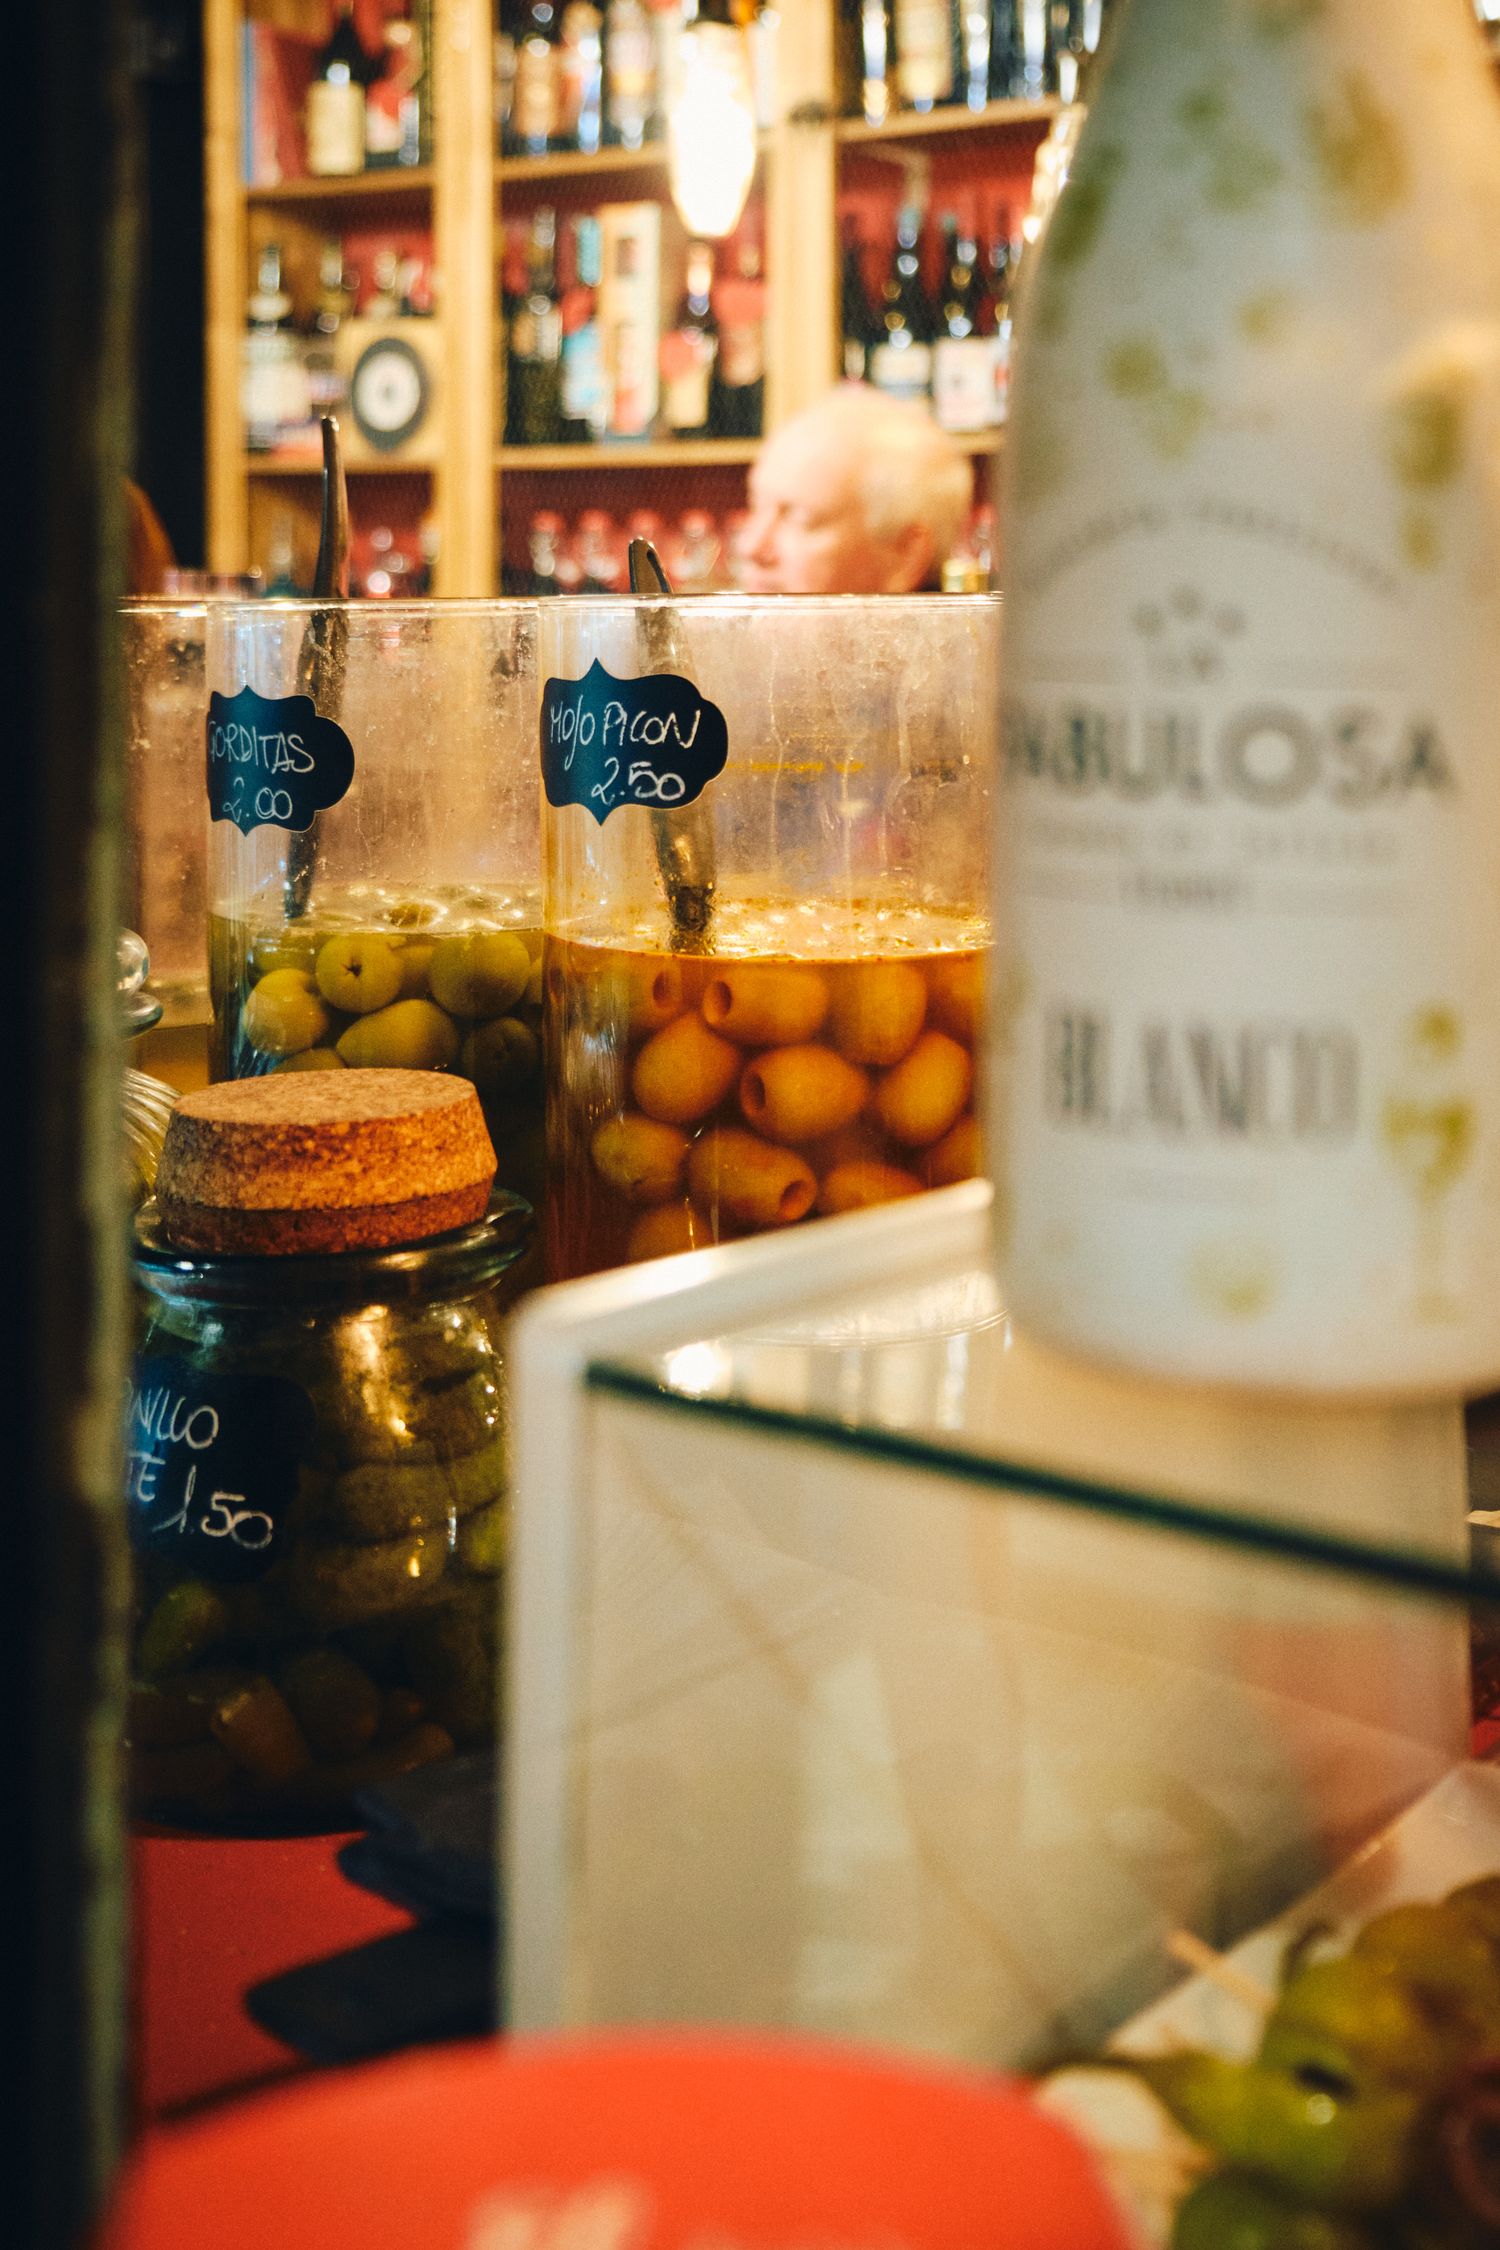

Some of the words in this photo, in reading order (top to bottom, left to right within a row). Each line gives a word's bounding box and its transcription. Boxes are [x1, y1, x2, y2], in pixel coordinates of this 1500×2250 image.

[603, 701, 701, 749] PICON
[222, 777, 293, 823] 2.00
[591, 757, 686, 806] 2.50
